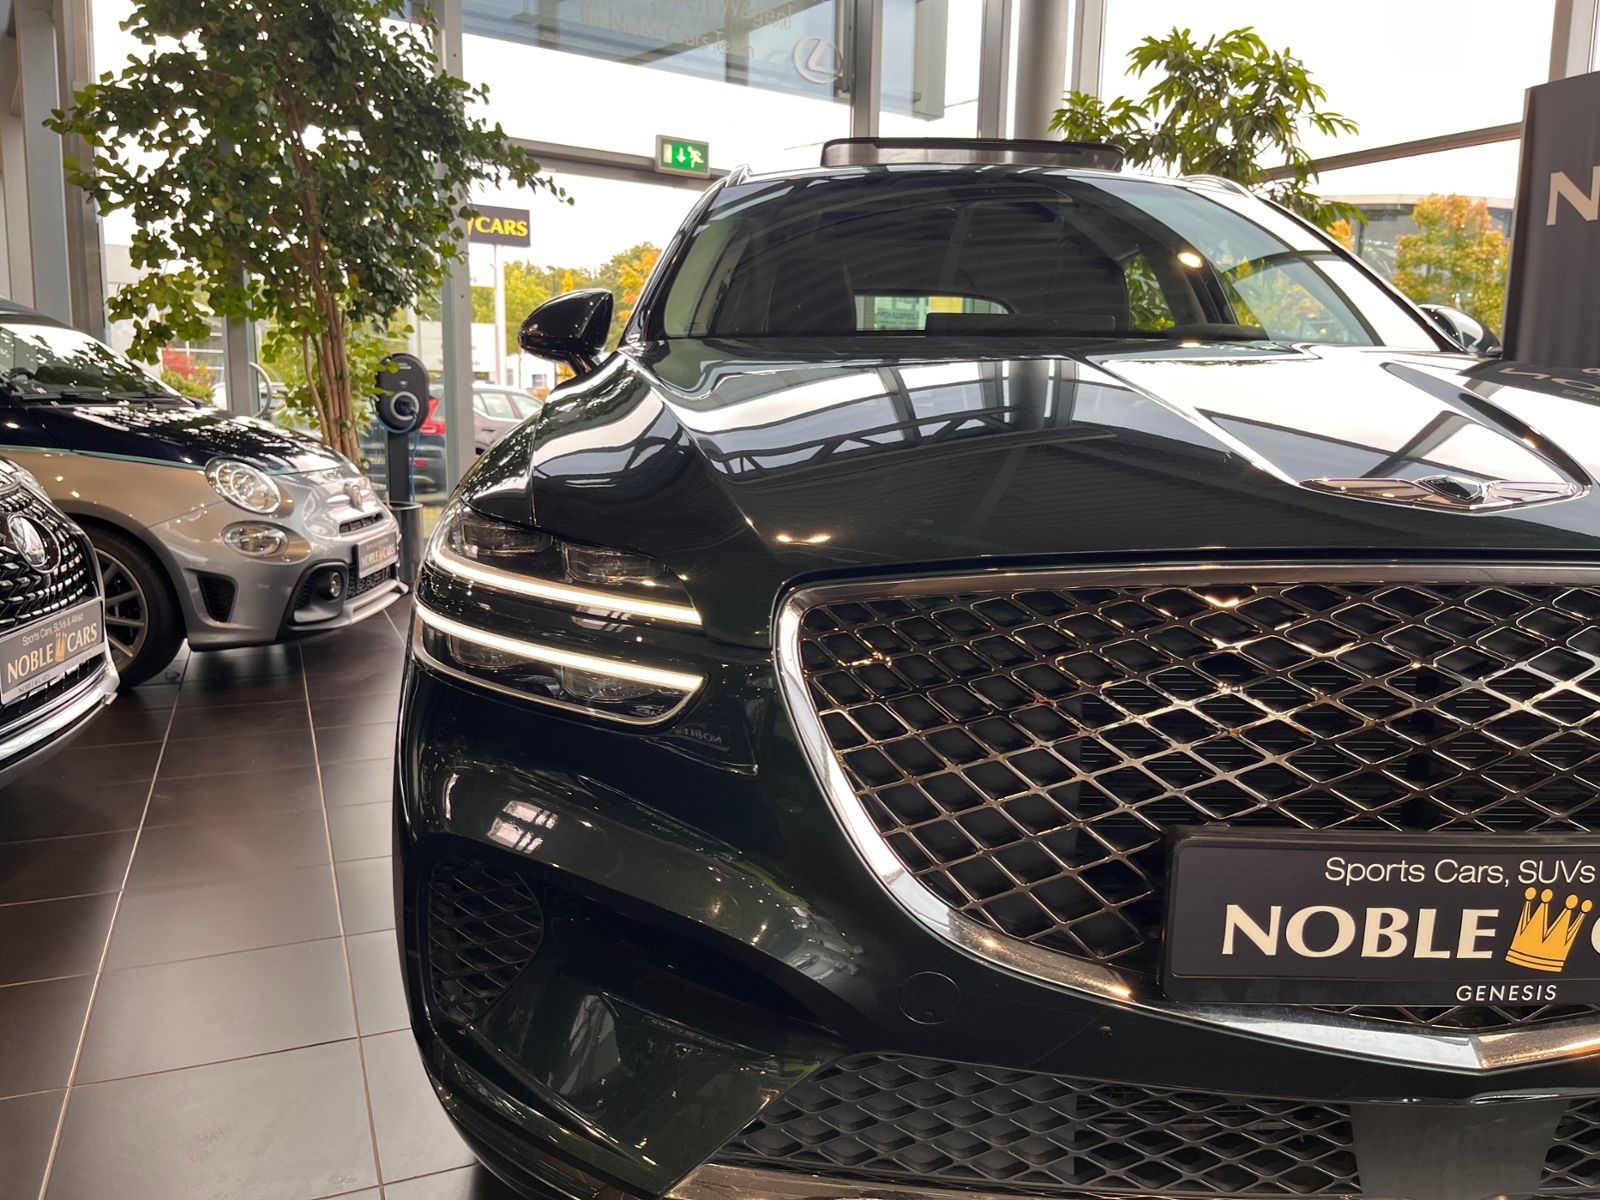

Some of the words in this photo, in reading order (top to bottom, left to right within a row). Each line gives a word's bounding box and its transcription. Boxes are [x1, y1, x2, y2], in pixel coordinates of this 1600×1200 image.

[475, 216, 529, 237] CARS
[7, 643, 54, 684] NOBLE
[67, 622, 98, 652] CARS
[1325, 856, 1425, 887] Sports
[1434, 858, 1510, 888] Cars,
[1517, 859, 1596, 885] SUVs
[1221, 904, 1499, 959] NOBLE
[1456, 984, 1557, 1002] GENESIS
